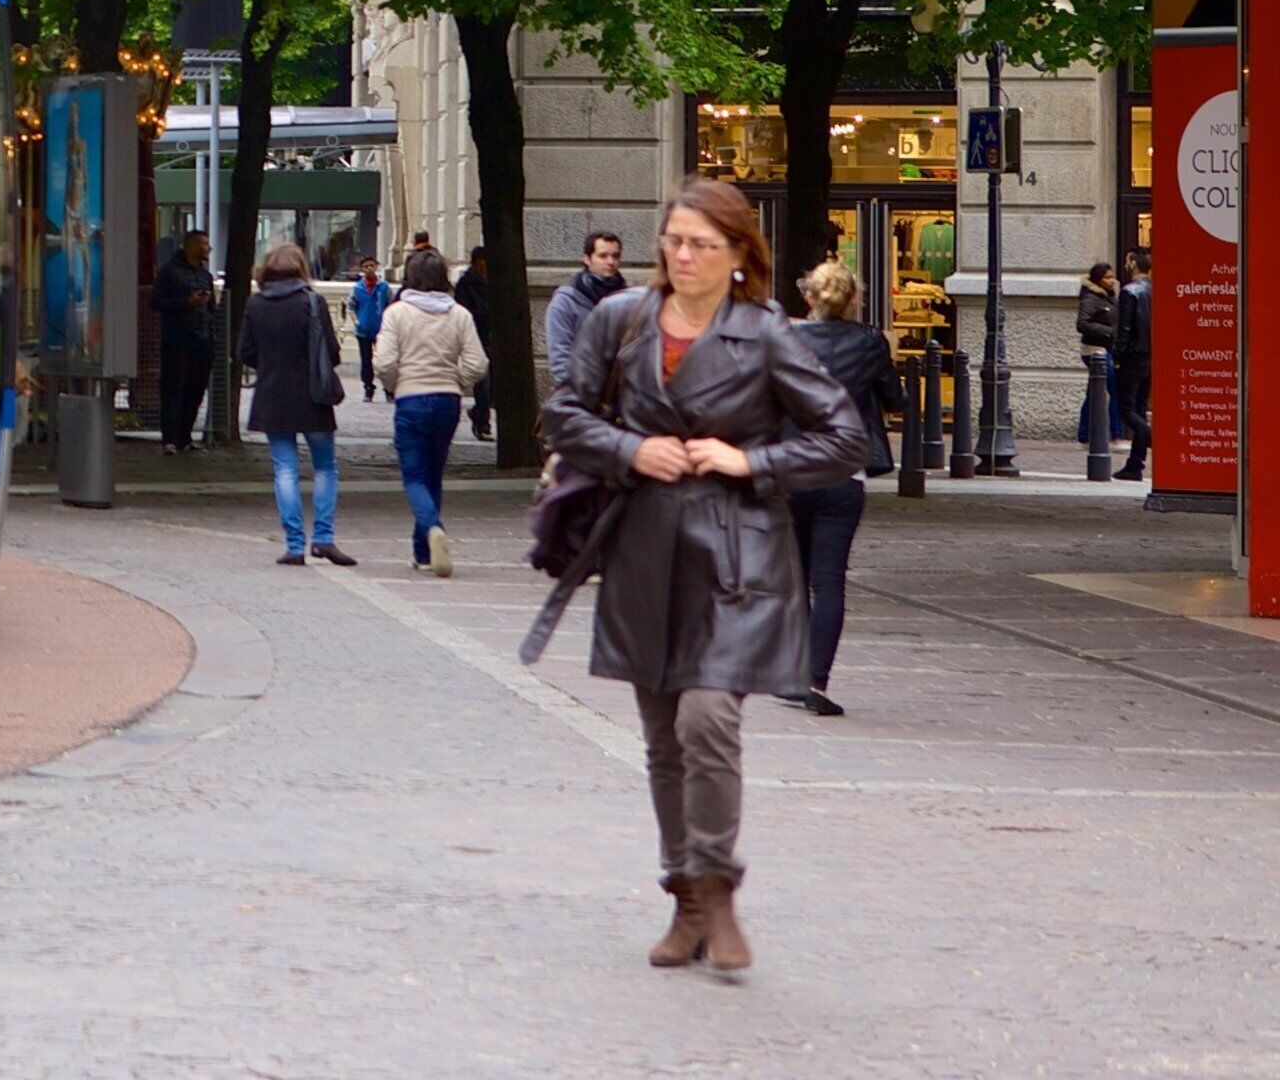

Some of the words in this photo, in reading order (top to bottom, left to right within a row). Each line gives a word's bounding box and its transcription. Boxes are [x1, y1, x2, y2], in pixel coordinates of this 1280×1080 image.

[1210, 123, 1239, 137] NOU
[1192, 186, 1239, 209] COL
[1189, 301, 1200, 311] et
[1202, 301, 1234, 312] retirez
[1197, 316, 1220, 328] dans
[1223, 319, 1234, 328] ce
[1182, 349, 1234, 361] COMMENT
